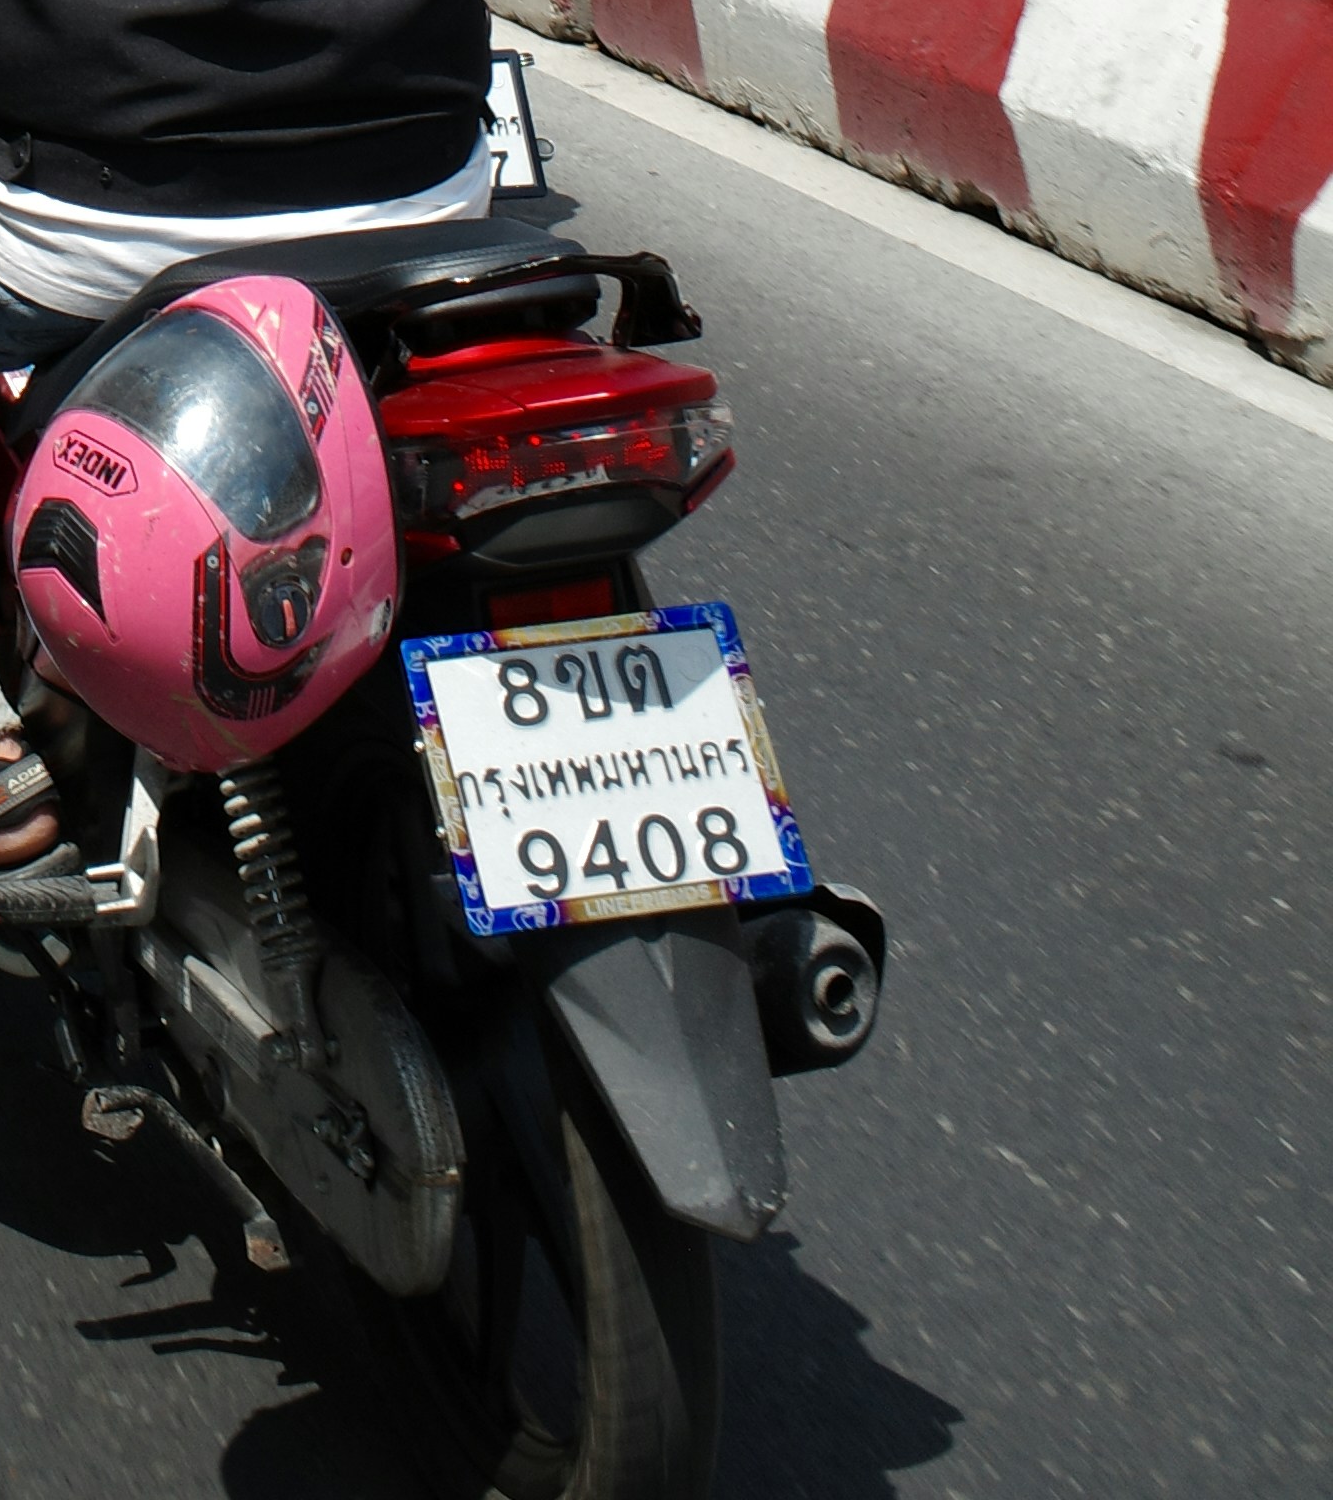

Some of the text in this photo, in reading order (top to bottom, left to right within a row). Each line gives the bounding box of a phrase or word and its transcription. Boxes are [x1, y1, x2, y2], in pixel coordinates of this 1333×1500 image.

[57, 436, 127, 490] INDEX
[455, 735, 751, 819] กรุงเทพมหานคร
[516, 805, 750, 901] 9408
